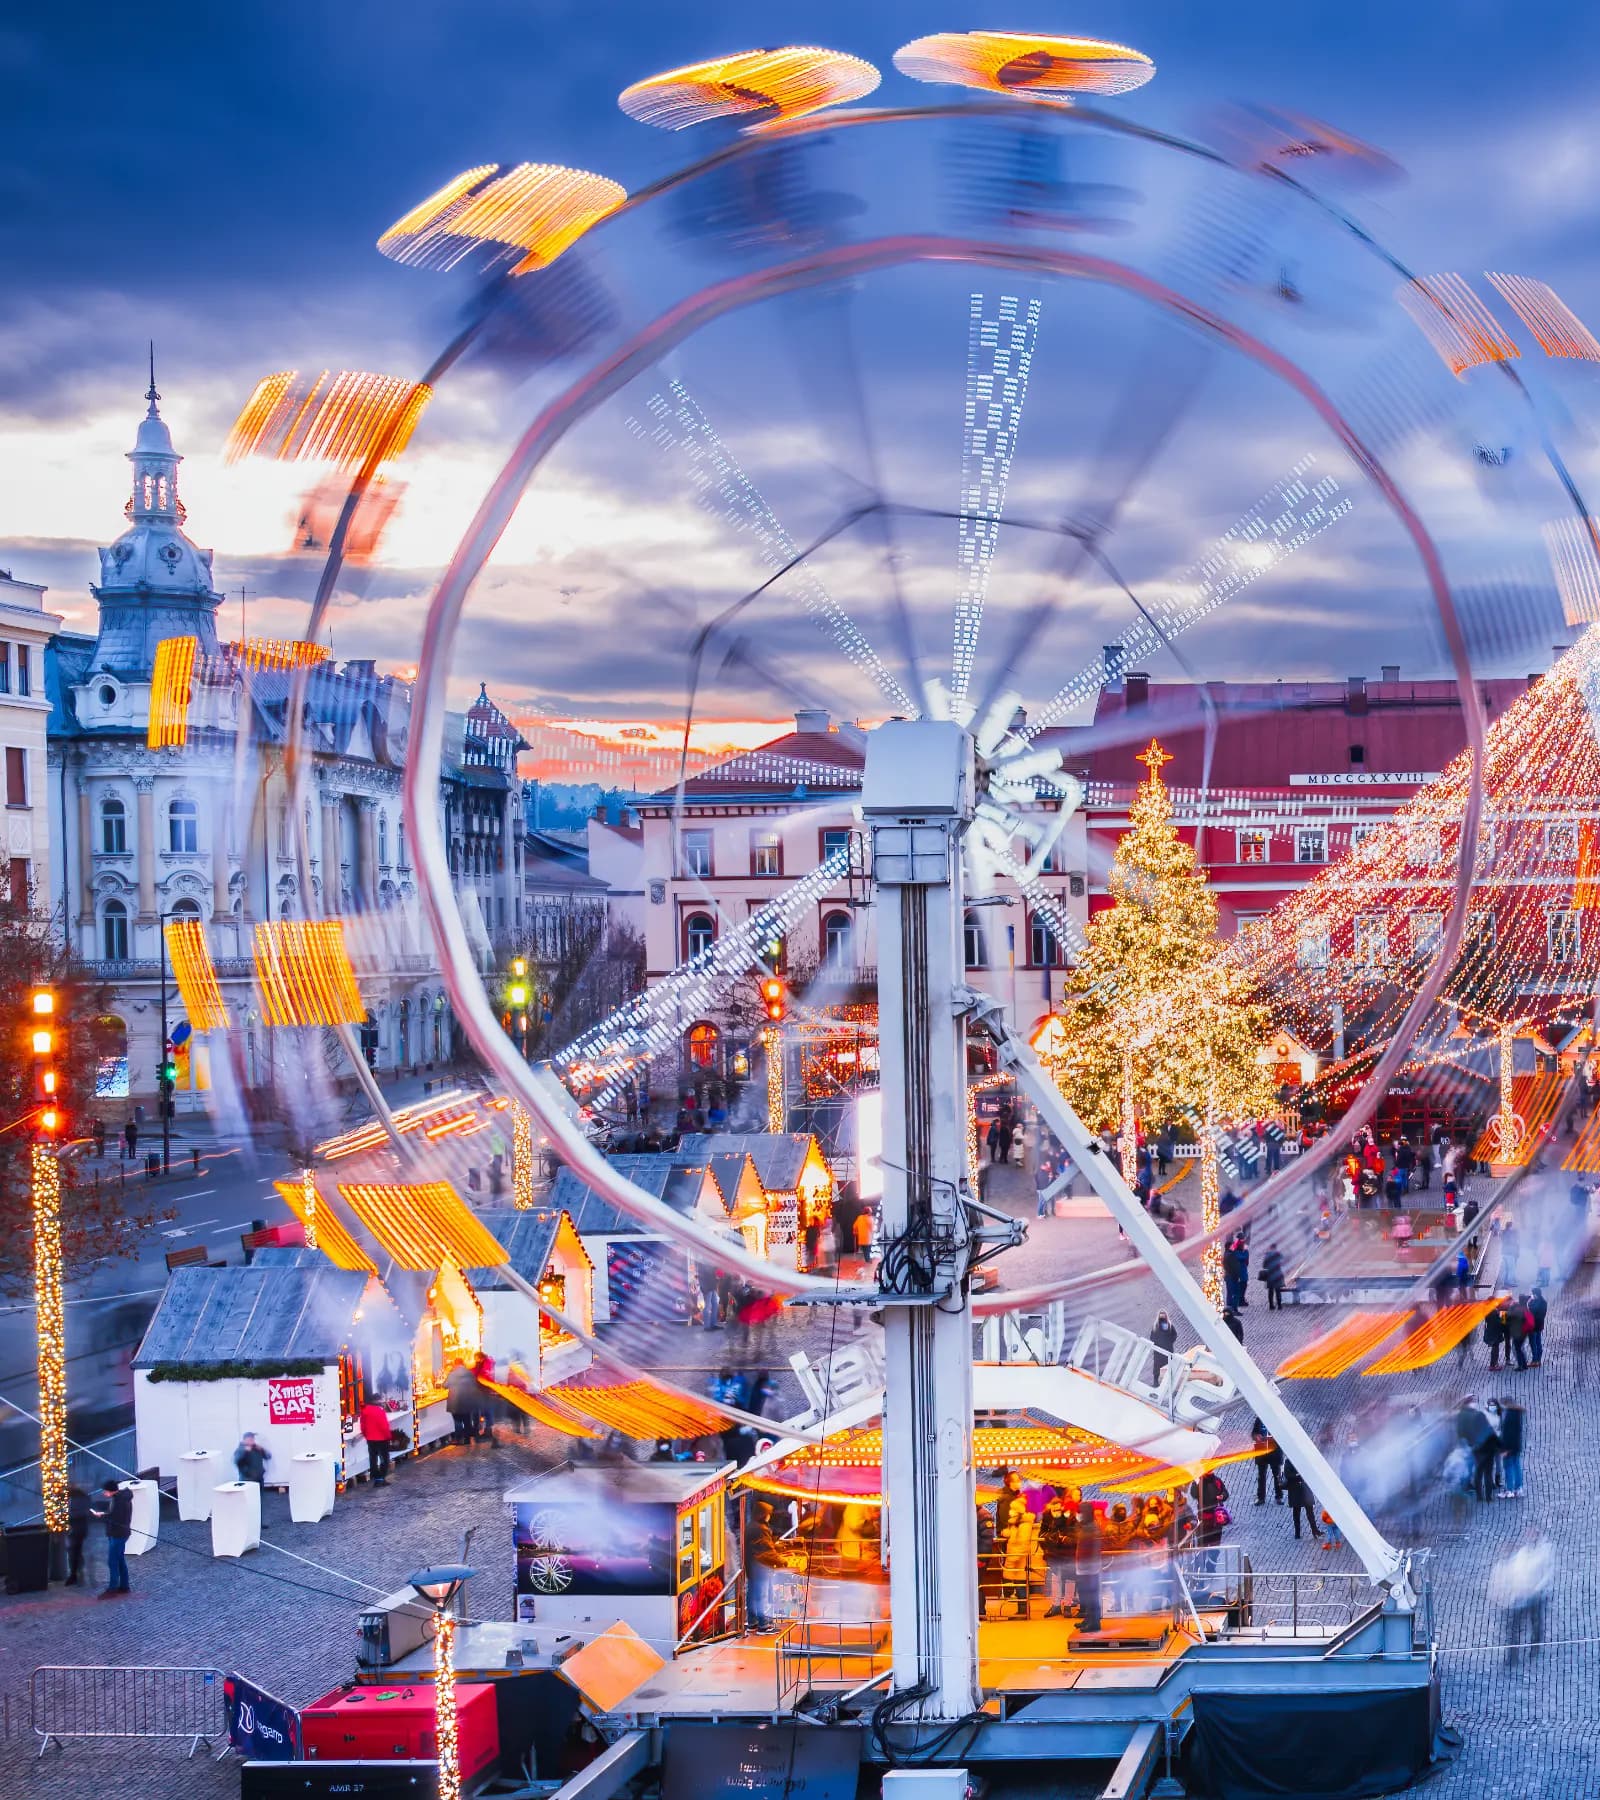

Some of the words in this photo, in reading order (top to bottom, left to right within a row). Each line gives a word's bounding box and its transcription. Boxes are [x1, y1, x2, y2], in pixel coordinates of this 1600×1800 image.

[1308, 773, 1424, 784] MDCCCXXVIII
[269, 1383, 314, 1402] Xmas
[272, 1396, 315, 1416] BAR
